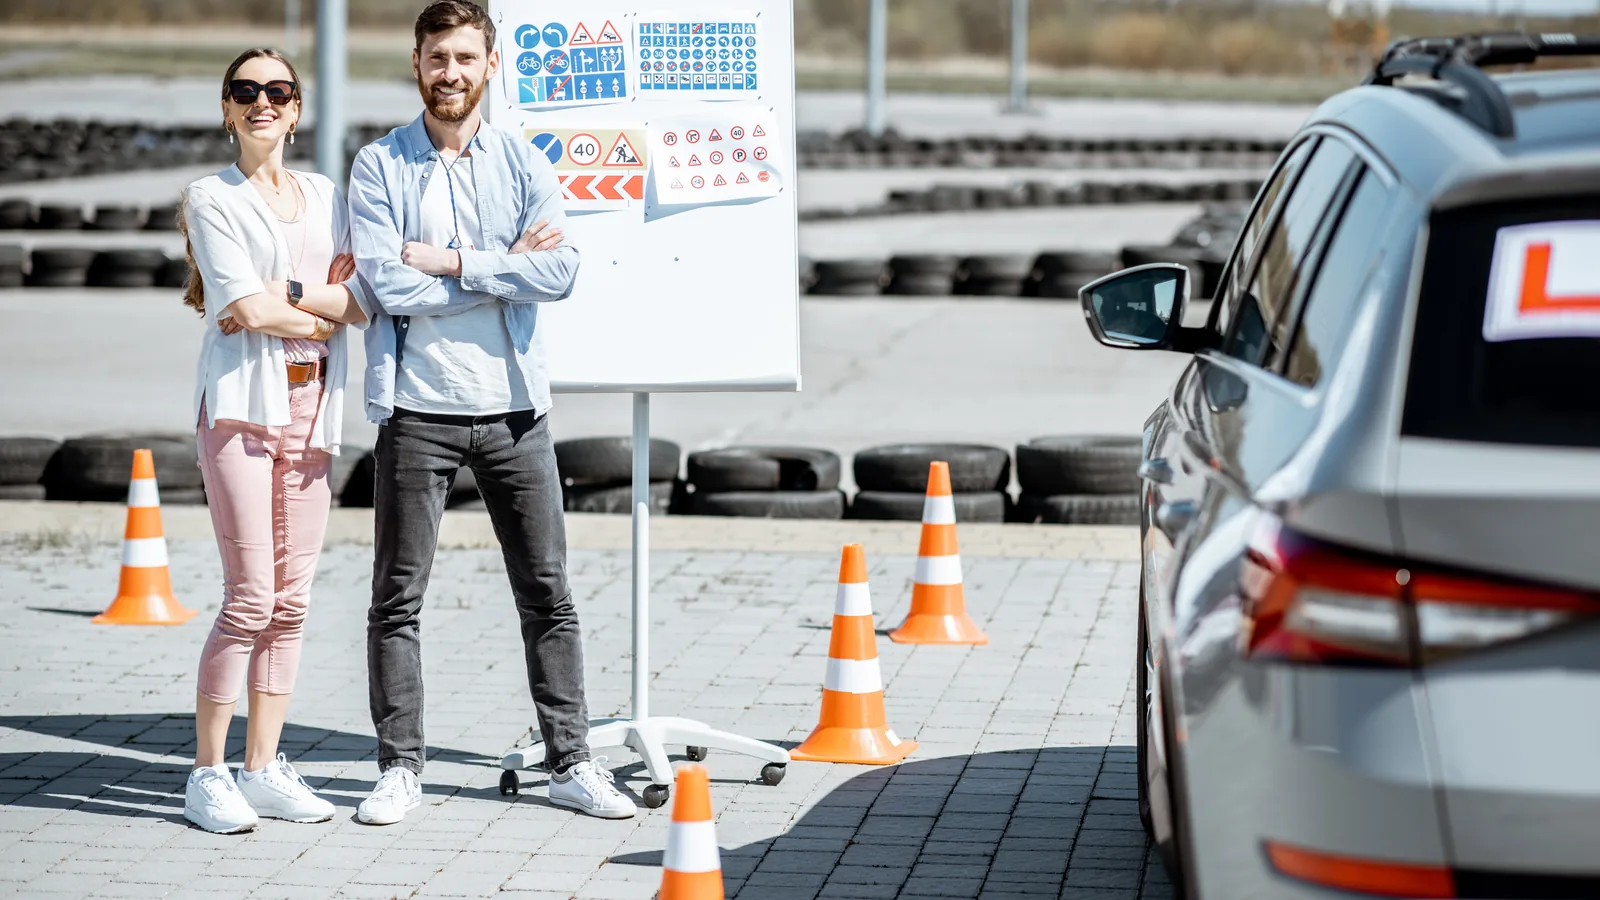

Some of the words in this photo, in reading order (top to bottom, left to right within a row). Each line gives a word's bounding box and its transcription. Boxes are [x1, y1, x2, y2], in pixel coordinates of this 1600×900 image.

[574, 143, 595, 156] 40
[737, 152, 743, 160] P
[1518, 242, 1600, 314] L
